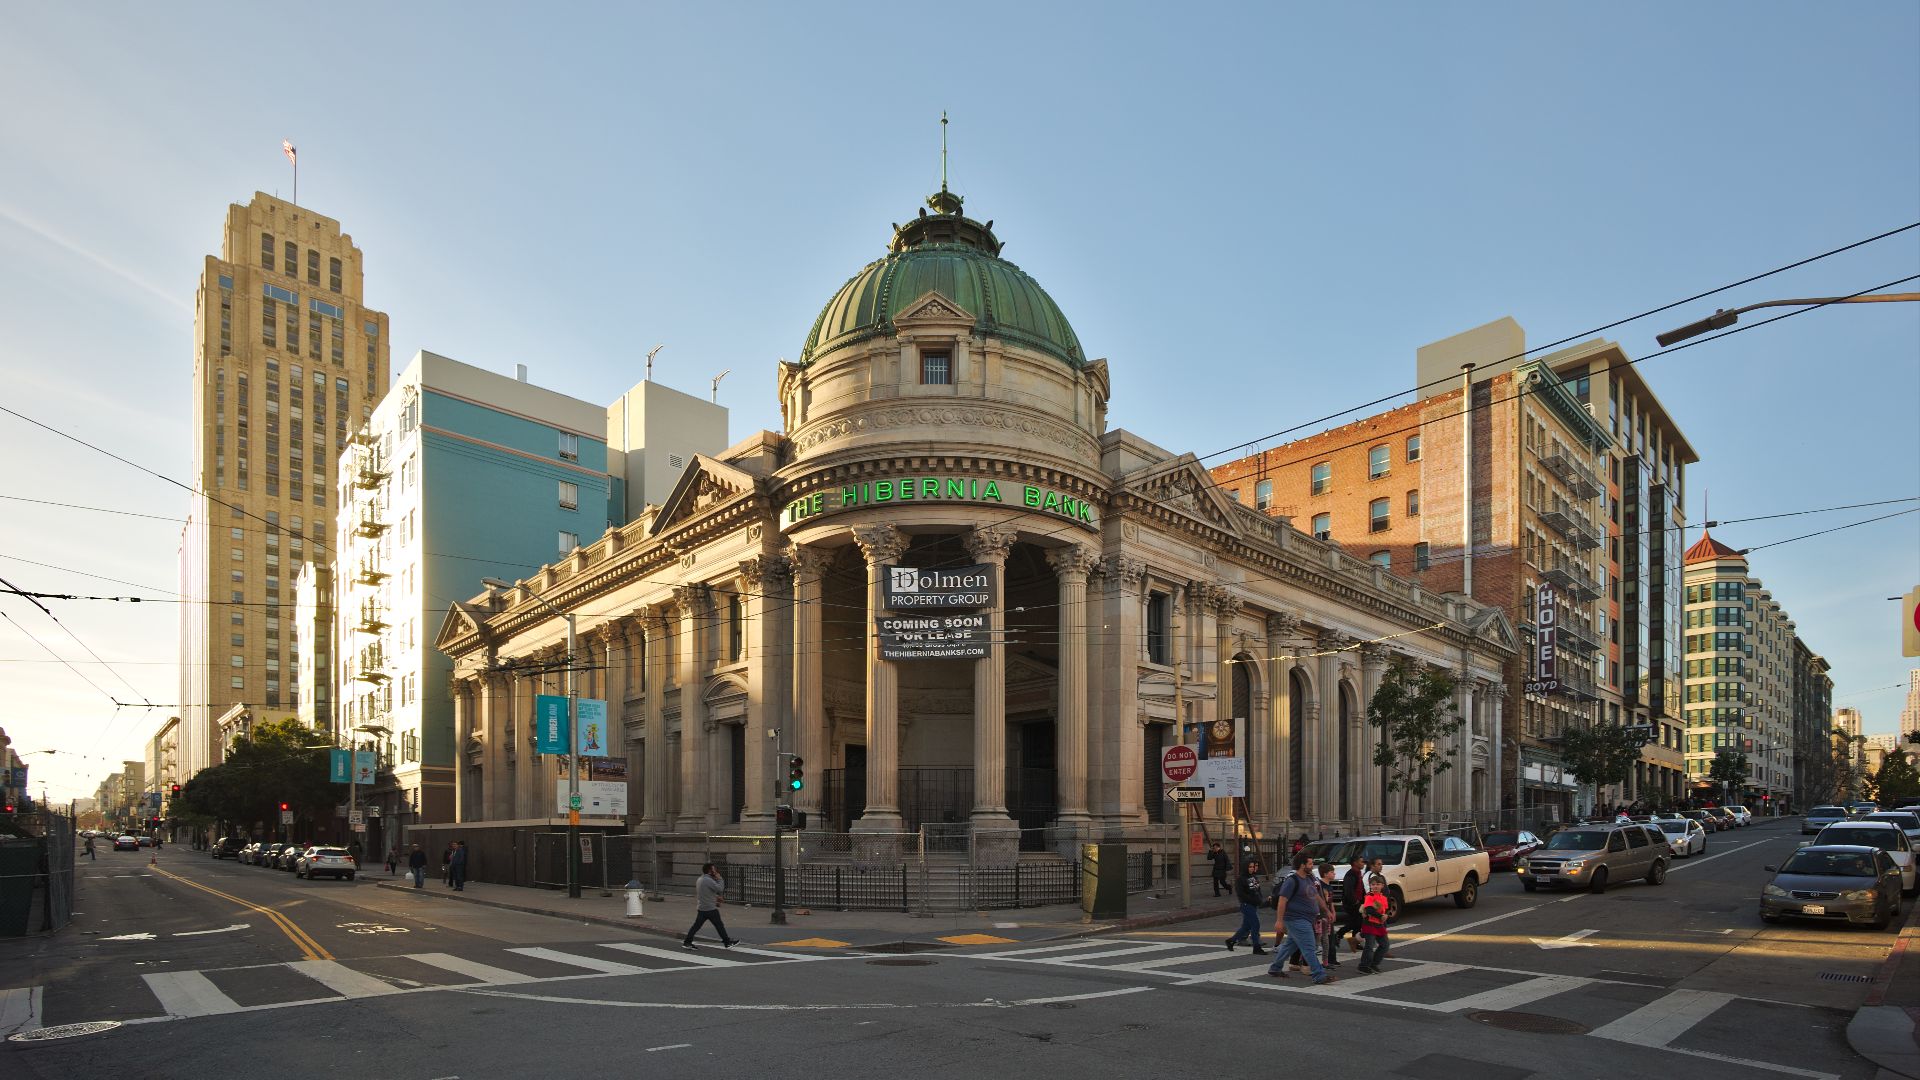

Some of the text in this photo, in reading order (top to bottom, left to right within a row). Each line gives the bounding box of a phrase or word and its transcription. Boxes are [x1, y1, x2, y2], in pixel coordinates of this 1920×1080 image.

[786, 478, 1092, 523] THE HIBERNIA BANK
[892, 568, 989, 591] Dolmen
[891, 594, 989, 606] PROPERTY GROUP
[883, 617, 983, 630] COMING SOON
[1539, 589, 1554, 678] HOTEL
[884, 648, 984, 658] THEHIBERNIABANKSF.COM
[1525, 681, 1557, 692] BOYD
[1179, 751, 1193, 759] NOT
[1169, 768, 1191, 776] ENTER
[1177, 790, 1201, 798] ONE WAY
